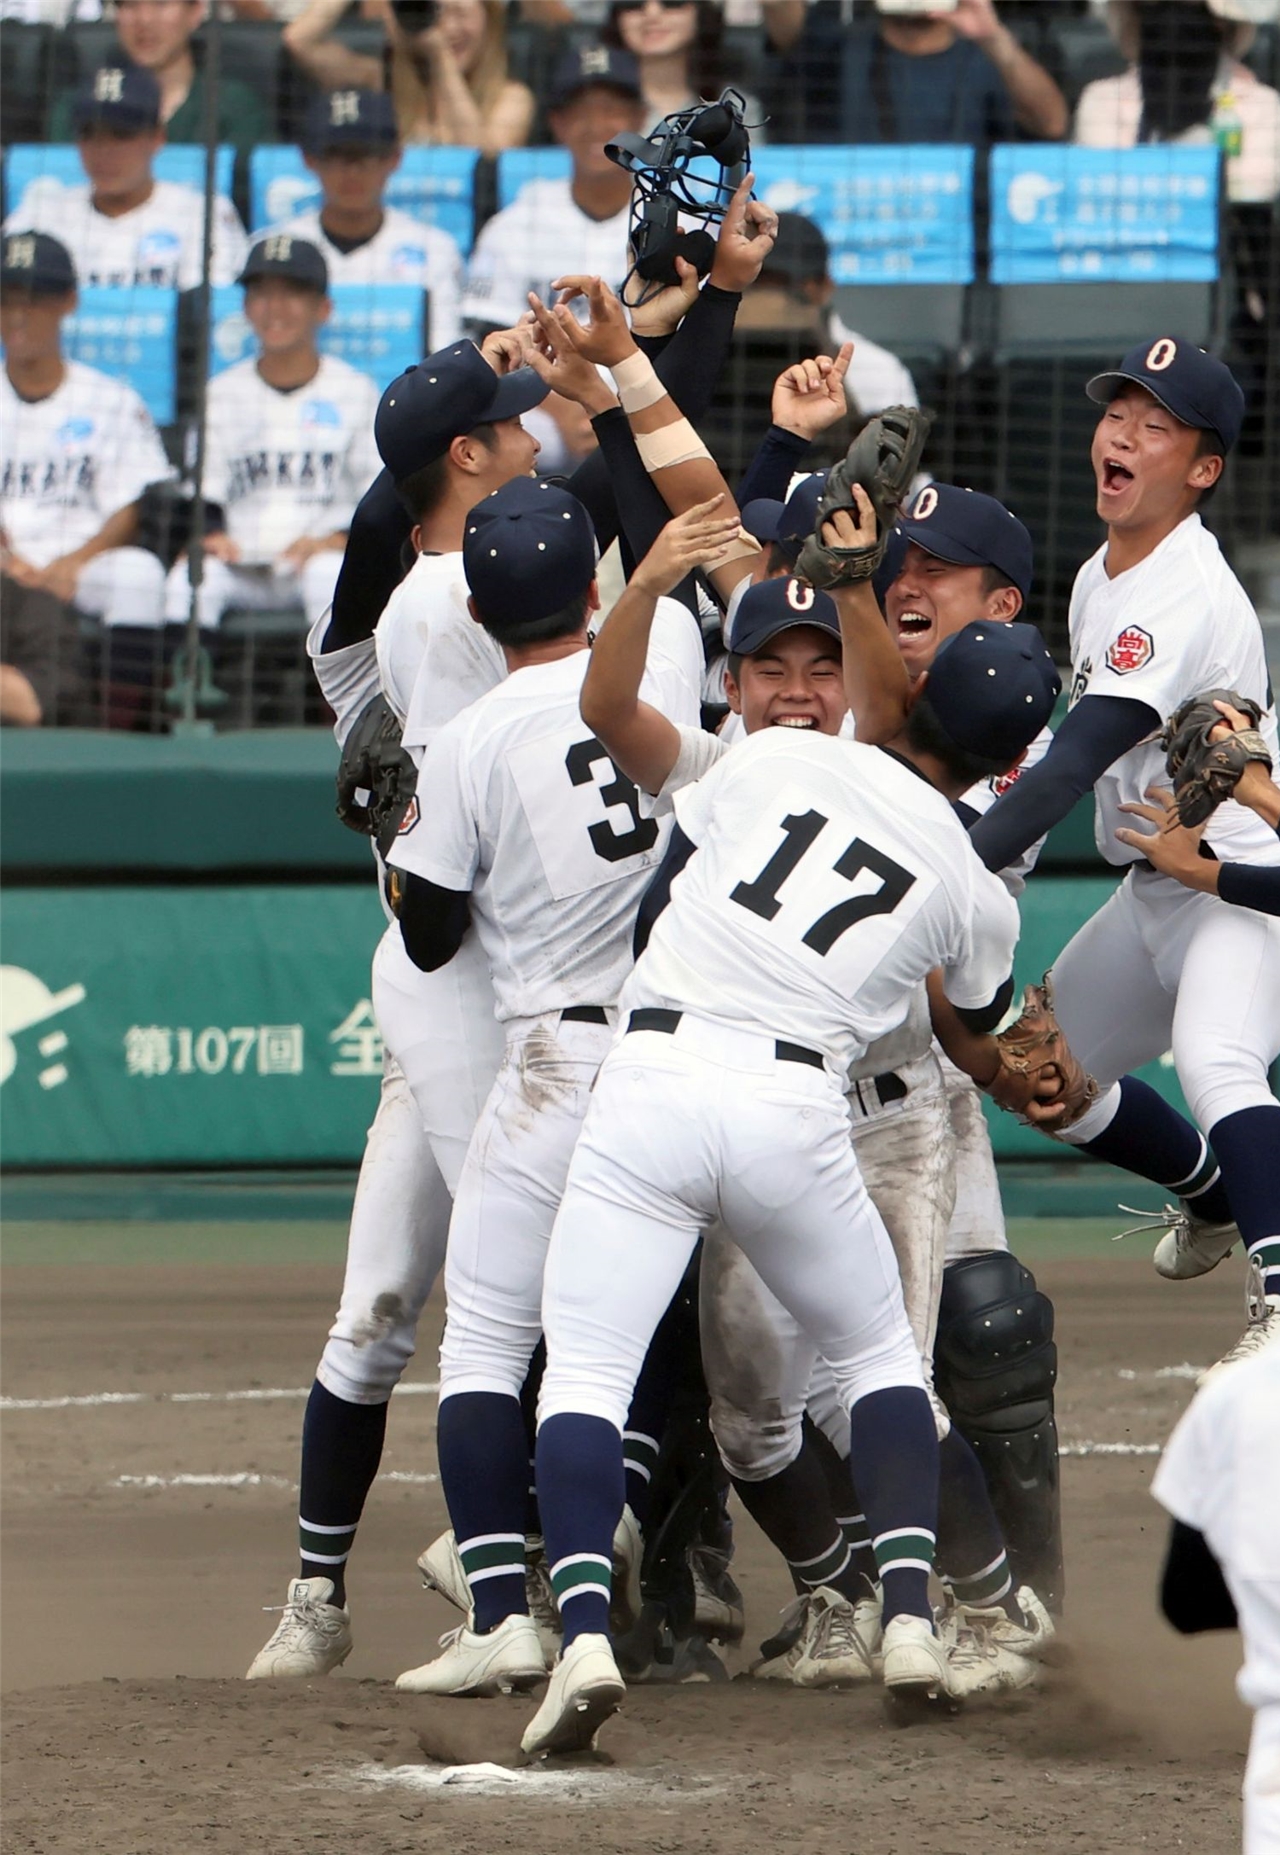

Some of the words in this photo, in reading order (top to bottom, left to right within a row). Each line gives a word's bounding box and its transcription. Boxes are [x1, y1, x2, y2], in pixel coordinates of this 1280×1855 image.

[565, 737, 659, 862] 3
[729, 808, 917, 956] 17
[124, 1022, 304, 1077] 第107回
[329, 998, 386, 1076] 全
